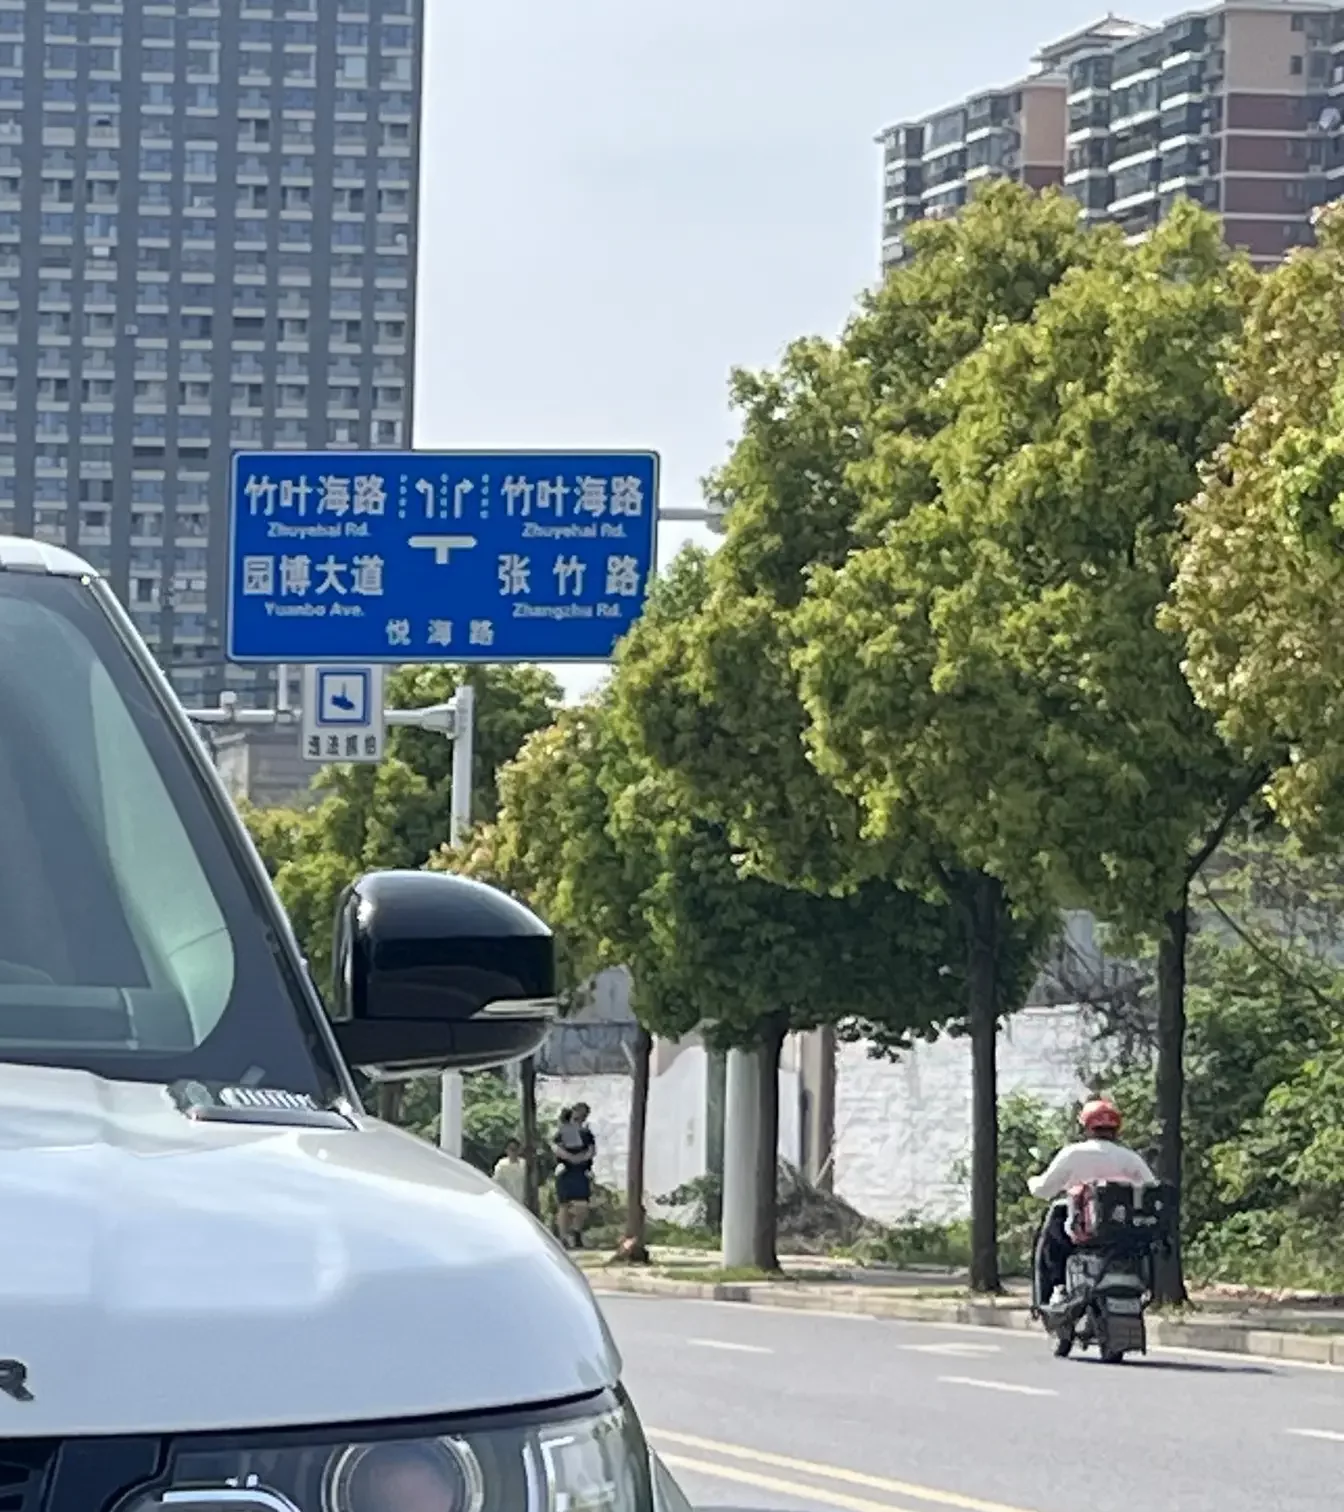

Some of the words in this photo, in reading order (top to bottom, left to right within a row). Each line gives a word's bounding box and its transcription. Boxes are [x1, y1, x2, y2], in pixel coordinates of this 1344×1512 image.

[243, 473, 387, 517] 竹叶海路
[500, 474, 644, 518] 竹叶海路
[242, 553, 385, 597] 园博大道
